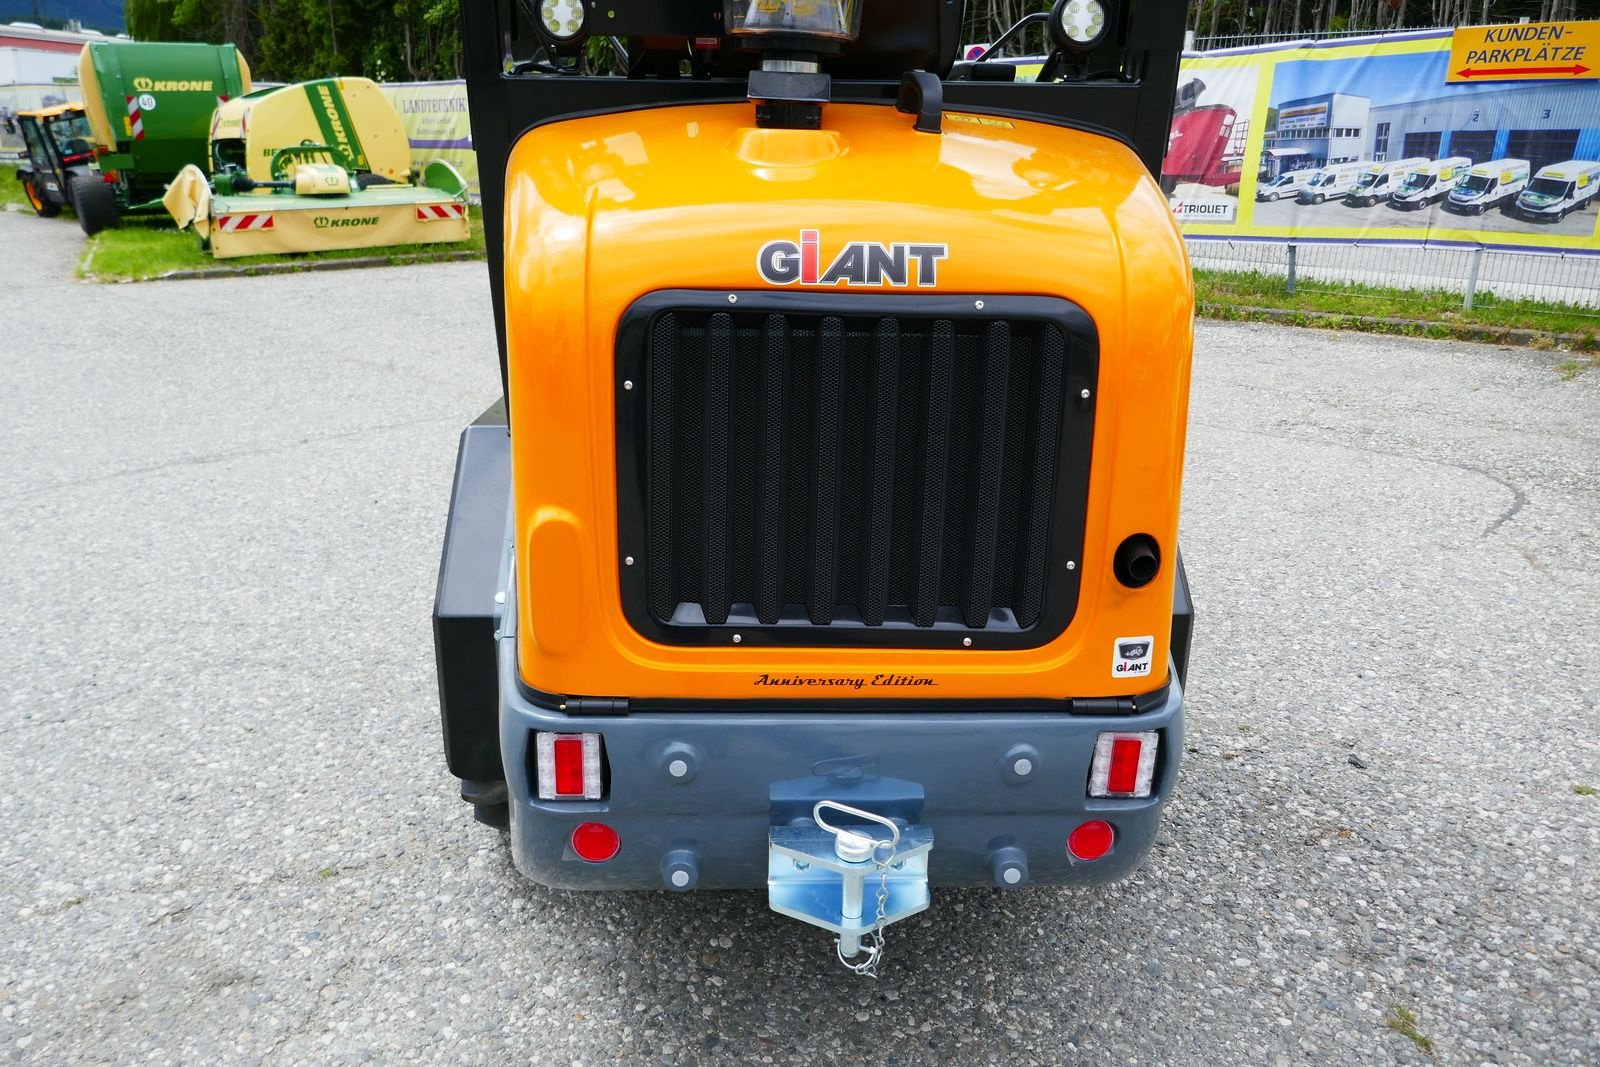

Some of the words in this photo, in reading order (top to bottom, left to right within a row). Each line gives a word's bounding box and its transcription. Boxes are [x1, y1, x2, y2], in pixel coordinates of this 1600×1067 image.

[1484, 25, 1574, 43] KUNDEN-
[1466, 43, 1586, 64] PARKPLÄTZE
[154, 80, 213, 91] KRONE
[142, 97, 154, 107] 40
[402, 98, 467, 113] LANDTECHNIK
[317, 84, 350, 145] KRONE
[1472, 113, 1479, 122] 2
[1542, 109, 1552, 119] 3
[1184, 204, 1228, 214] TRIOLIET
[330, 216, 380, 228] KRONE
[753, 674, 868, 690] Anniversary
[871, 674, 940, 687] Edition
